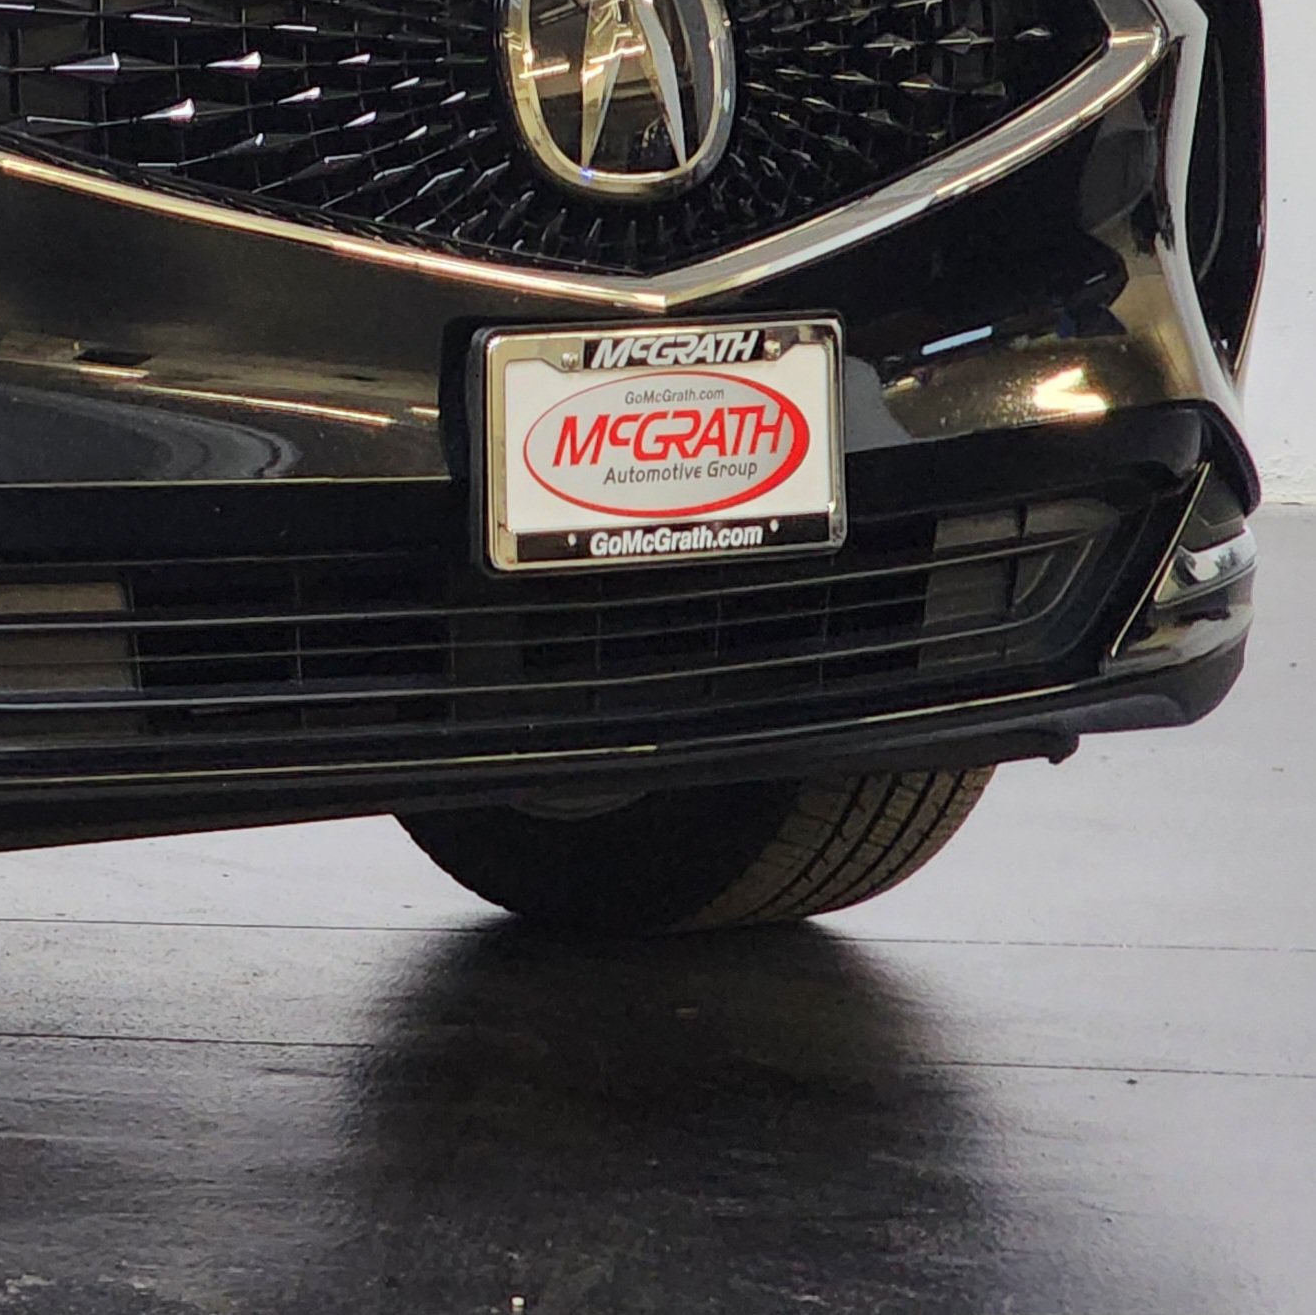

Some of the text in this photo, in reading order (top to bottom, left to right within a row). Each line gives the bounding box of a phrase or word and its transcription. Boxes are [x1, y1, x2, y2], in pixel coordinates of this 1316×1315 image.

[625, 388, 724, 405] GoMcGrath.com
[603, 459, 758, 485] Automotive Group
[590, 525, 763, 556] GoMcGrath.com
